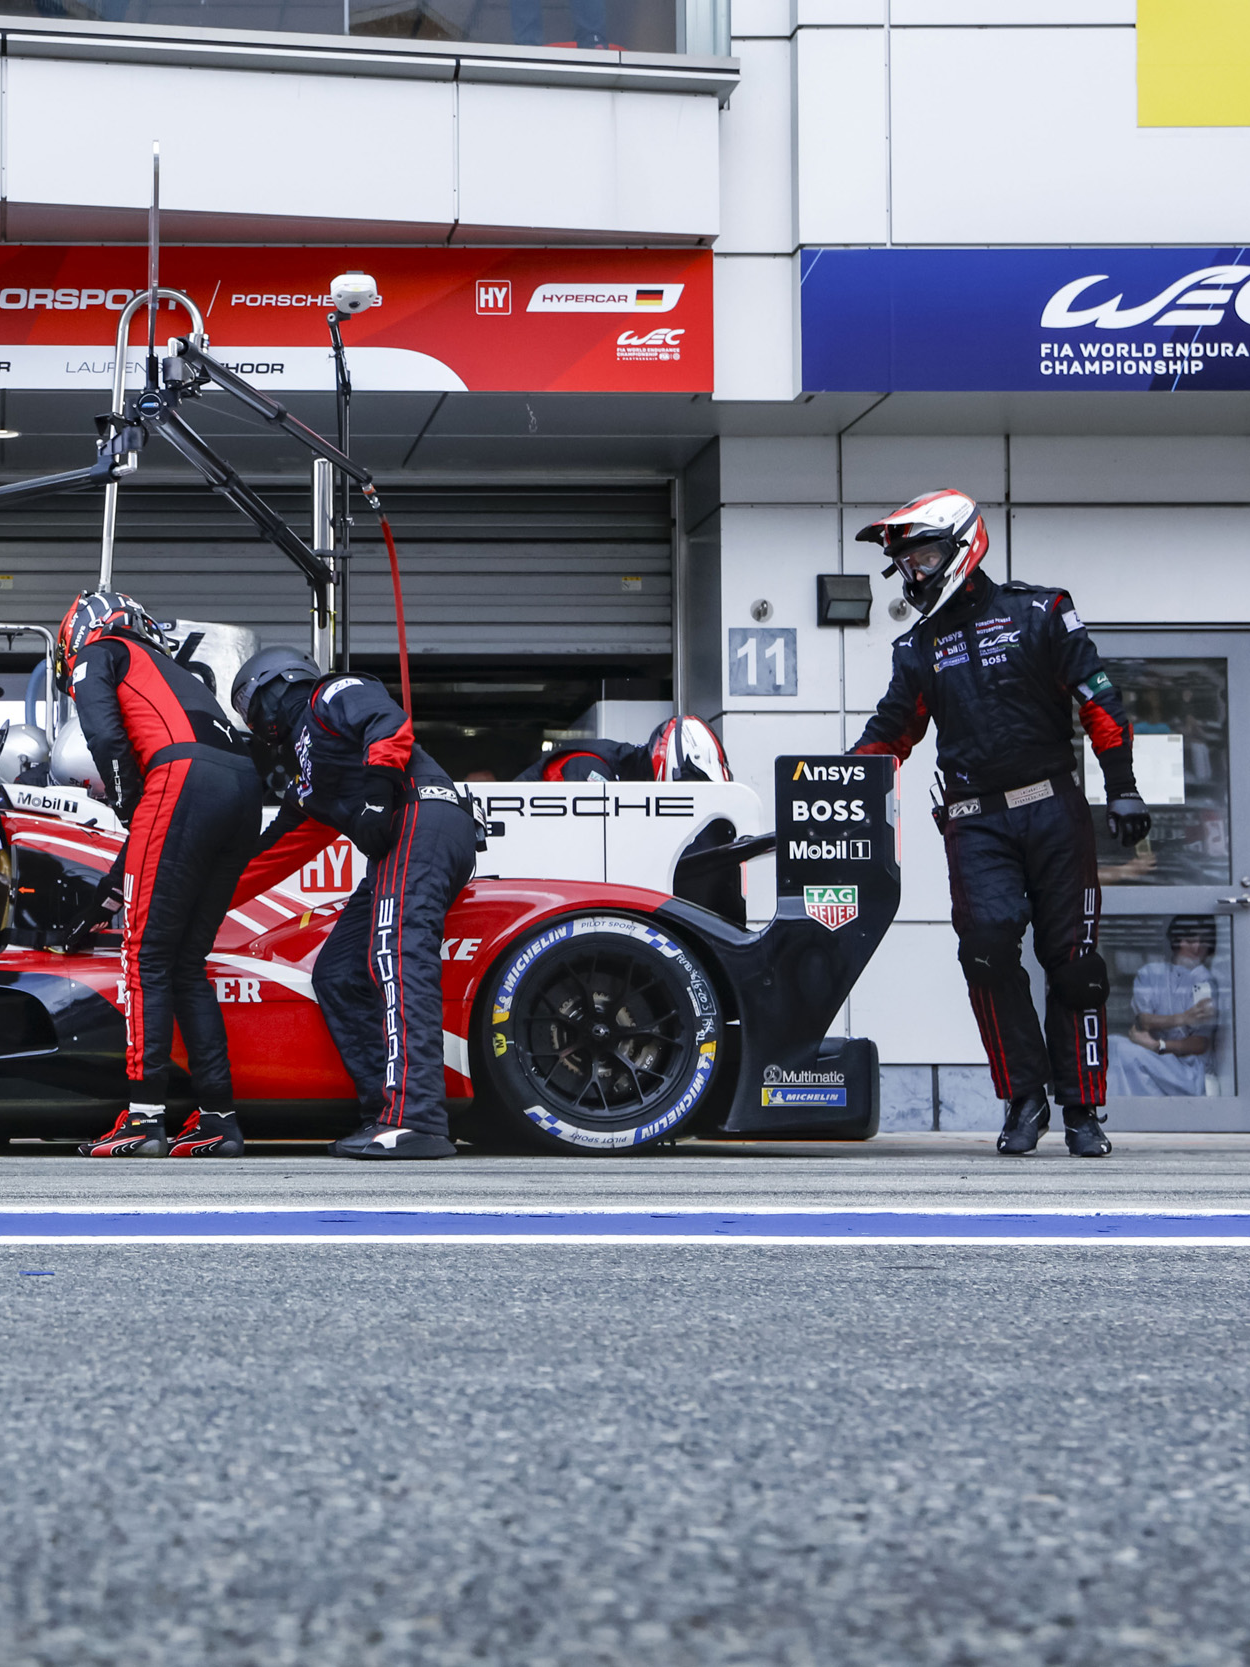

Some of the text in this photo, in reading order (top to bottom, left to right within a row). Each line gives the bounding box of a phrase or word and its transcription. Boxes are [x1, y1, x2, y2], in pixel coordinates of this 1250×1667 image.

[231, 294, 335, 307] PORSCHE
[480, 287, 508, 308] HY
[542, 294, 628, 303] HYPERCAR
[617, 328, 685, 345] WEC
[1040, 343, 1250, 358] FIA WORLD ENDURA
[1040, 360, 1204, 375] CHAMPIONSHIP
[72, 625, 86, 652] Ansys
[933, 631, 964, 646] Ansys
[979, 630, 1021, 648] WEC
[737, 637, 785, 685] 11
[981, 654, 1007, 667] BOSS
[792, 761, 866, 785] Ansys
[18, 792, 60, 810] Mobil
[474, 796, 694, 817] RSCHE
[792, 800, 865, 821] BOSS
[789, 840, 847, 860] Mobil
[303, 845, 348, 888] HY
[808, 889, 853, 903] TAG
[809, 905, 855, 928] HEUER
[581, 920, 637, 932] PILOT SPORT
[503, 925, 568, 993] MICHELIN
[376, 897, 400, 1088] PORSCHE
[783, 1071, 844, 1083] Multimatic
[641, 1072, 705, 1140] MICHELIN
[570, 1132, 627, 1144] PILOT SPORT
